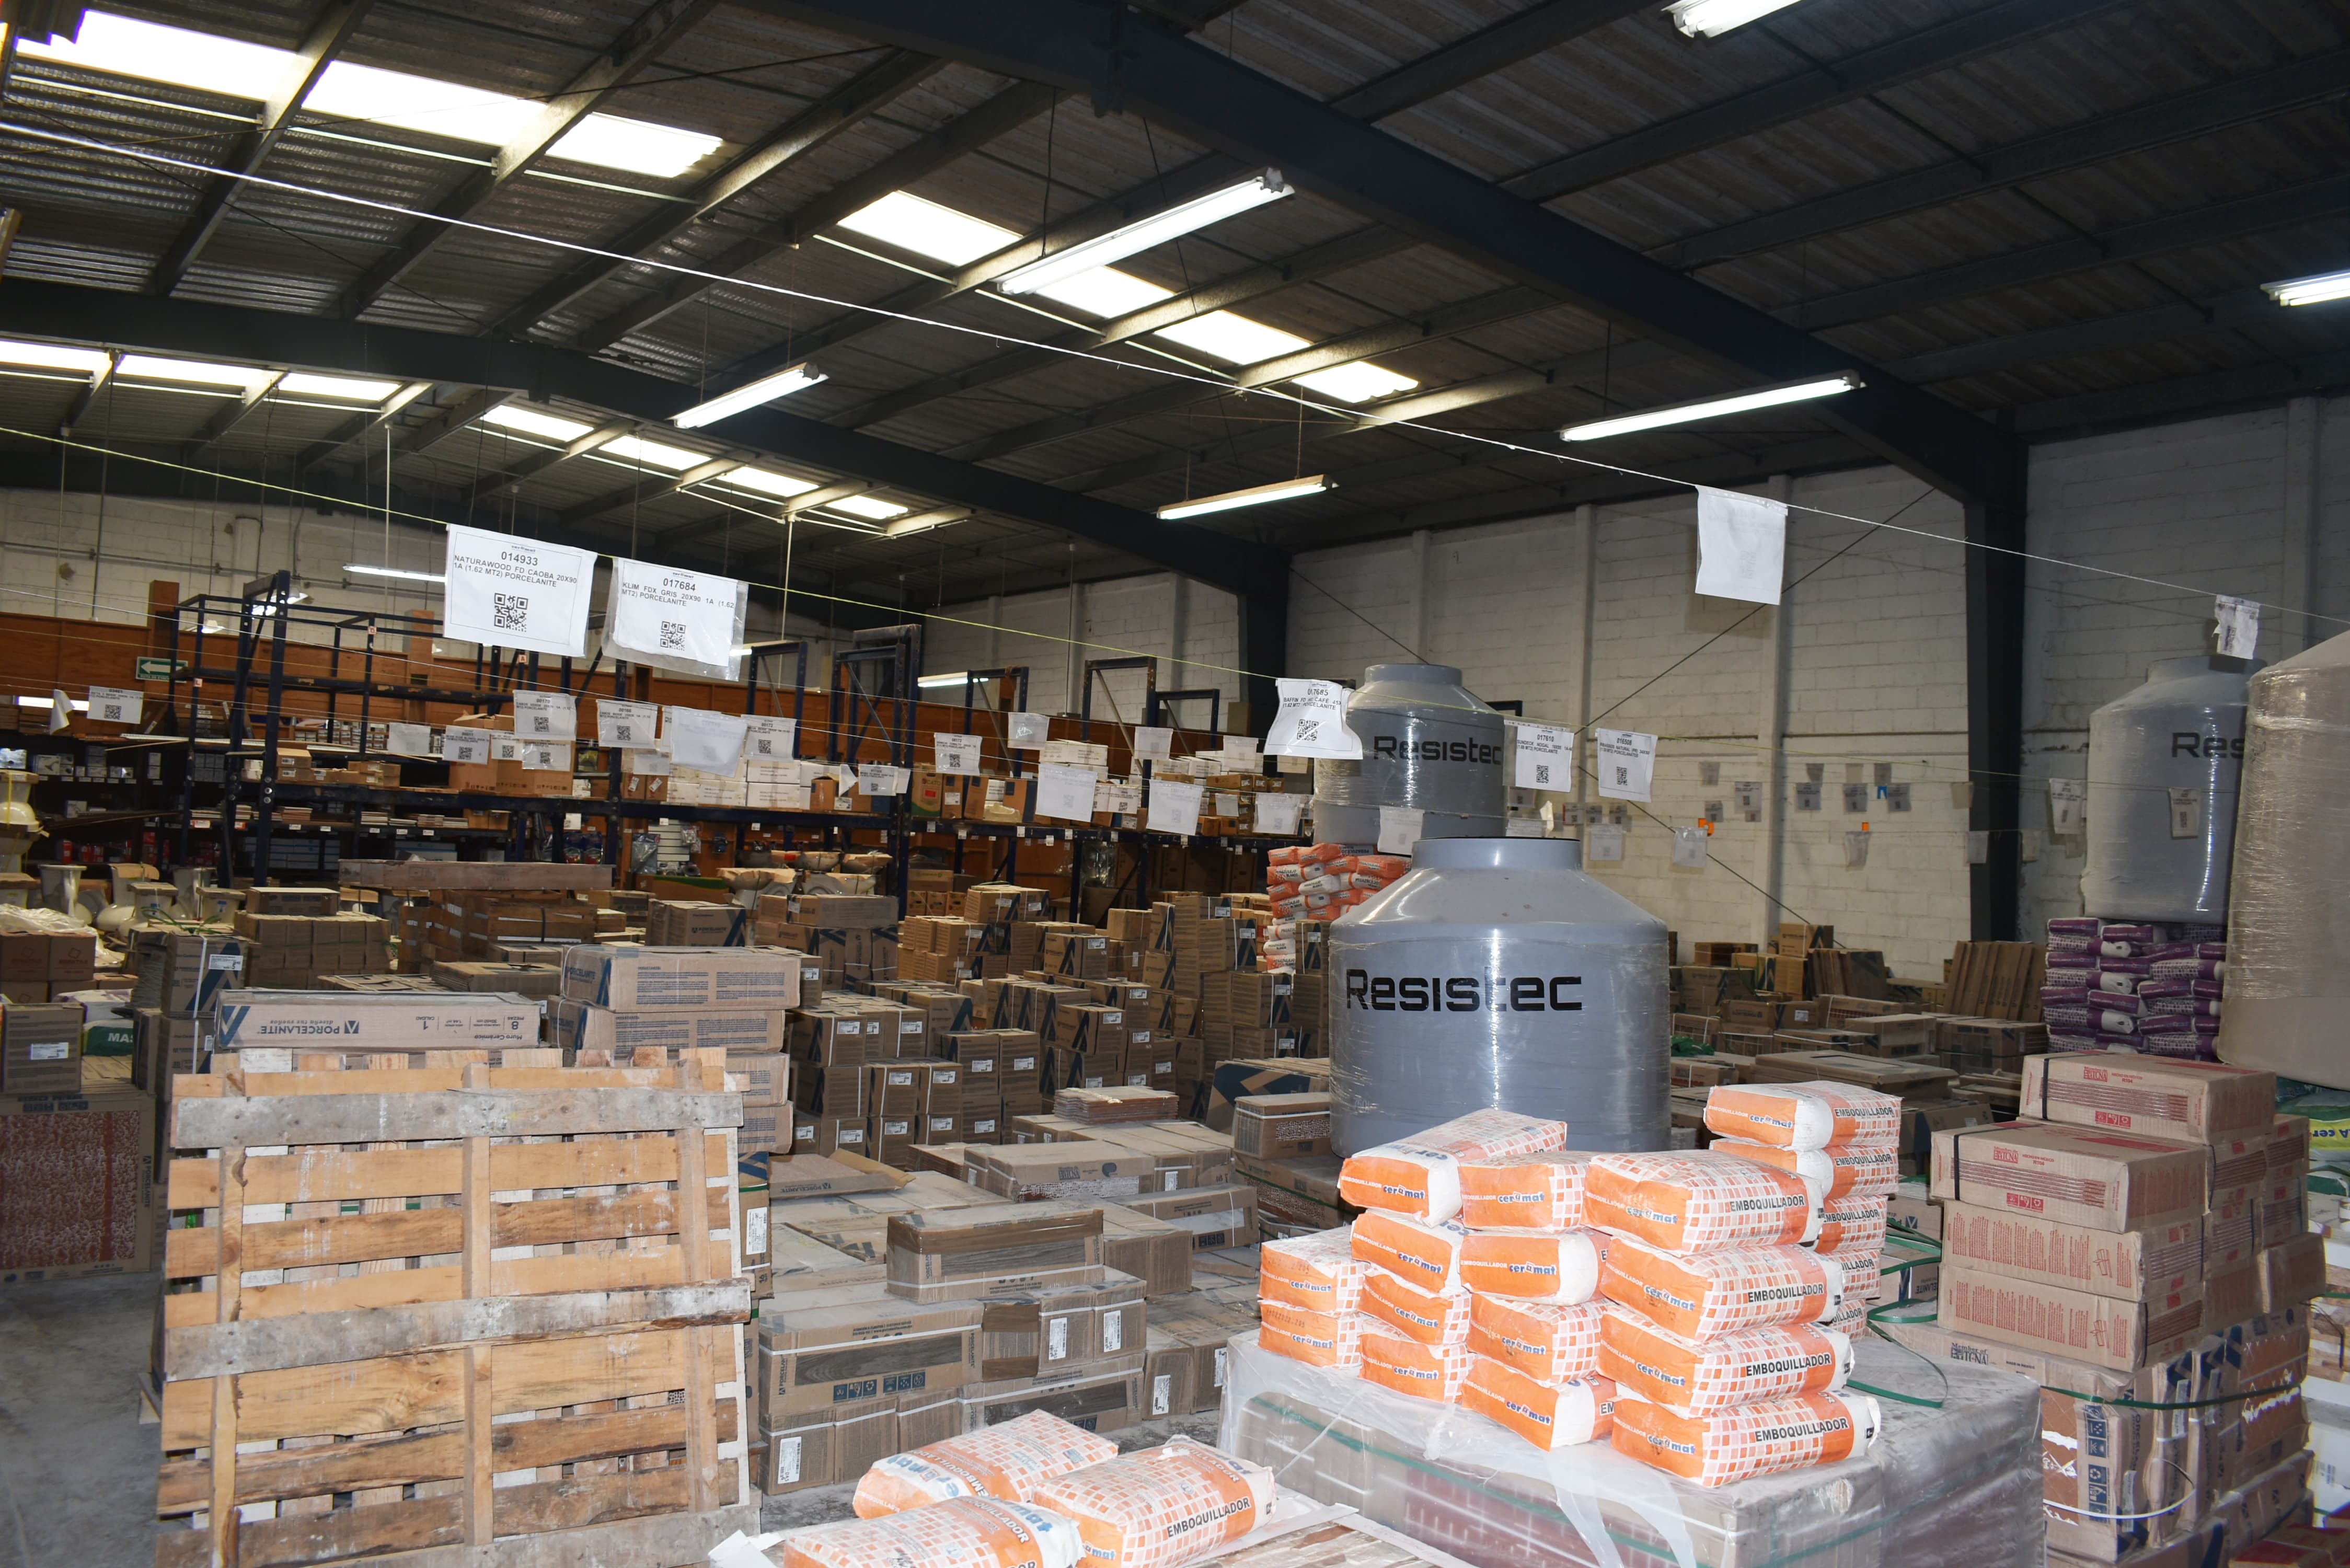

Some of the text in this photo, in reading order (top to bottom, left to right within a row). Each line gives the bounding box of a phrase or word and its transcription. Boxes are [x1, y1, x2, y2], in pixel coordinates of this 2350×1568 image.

[501, 551, 538, 566] 014933
[454, 555, 511, 571] NATURAWOOD
[528, 569, 554, 579] CAOBA
[556, 574, 577, 583] 20X90
[465, 565, 482, 573] (1.62
[485, 569, 503, 578] MT2)
[505, 572, 557, 587] PORCELANITE
[623, 582, 639, 590] KLIM
[682, 593, 701, 602] 20X90
[663, 578, 696, 591] 017684
[622, 589, 687, 606] MT2) PORCELANITE
[1374, 736, 1502, 765] Resistec
[1346, 966, 1582, 1012] Resistec
[260, 1025, 340, 1034] PORCELANITE
[423, 1021, 428, 1030] 1
[511, 1021, 519, 1030] 8
[1835, 1106, 1894, 1117] EMBOQUILLADOR
[1835, 1154, 1892, 1167] EMBOQUILLADOR
[1730, 1195, 1805, 1212] EMBOQUILLADOR
[1353, 1233, 1398, 1254] EMBOQUILLADOR
[1461, 1260, 1508, 1269] EMBOQUILLADOR
[1748, 1284, 1823, 1303] EMBOQUILLADOR
[1952, 1342, 1979, 1353] Member
[1746, 1353, 1831, 1377] EMBOQUILLADOR
[1755, 1417, 1848, 1442] EMBOQUILLADOR
[1167, 1497, 1251, 1538] EMBOQUILLADOR
